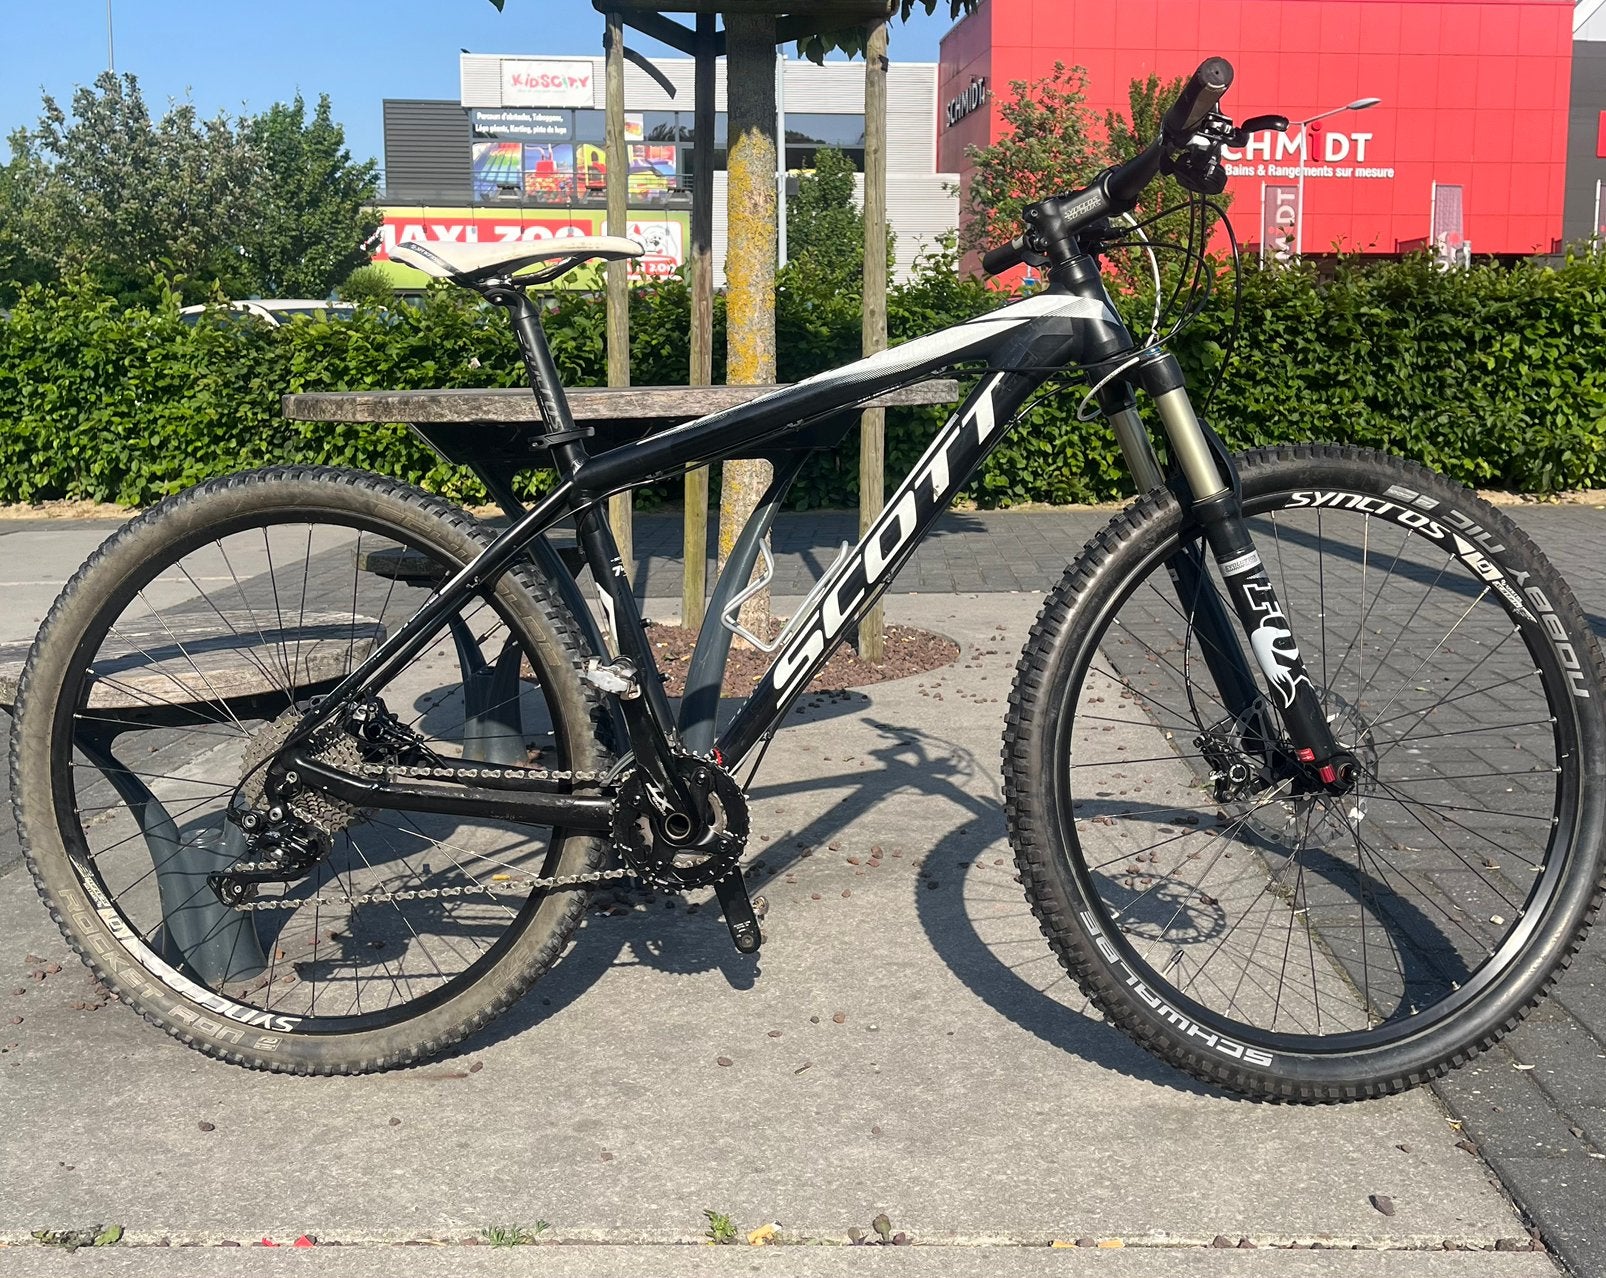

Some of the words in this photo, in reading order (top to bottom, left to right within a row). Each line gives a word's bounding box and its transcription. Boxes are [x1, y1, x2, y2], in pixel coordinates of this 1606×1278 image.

[1225, 164, 1254, 177] Bains
[1257, 165, 1266, 176] &
[1268, 164, 1333, 179] Rangements
[1336, 169, 1353, 177] sur
[1355, 168, 1394, 178] mesure
[773, 371, 1005, 710] SCOTT
[1285, 491, 1453, 539] SYNCROS
[1441, 509, 1506, 554] NIC
[1504, 567, 1590, 698] NOBBY
[58, 889, 165, 999] ROCKET
[167, 1005, 245, 1045] RON
[1080, 911, 1274, 1067] SCHWALBE
